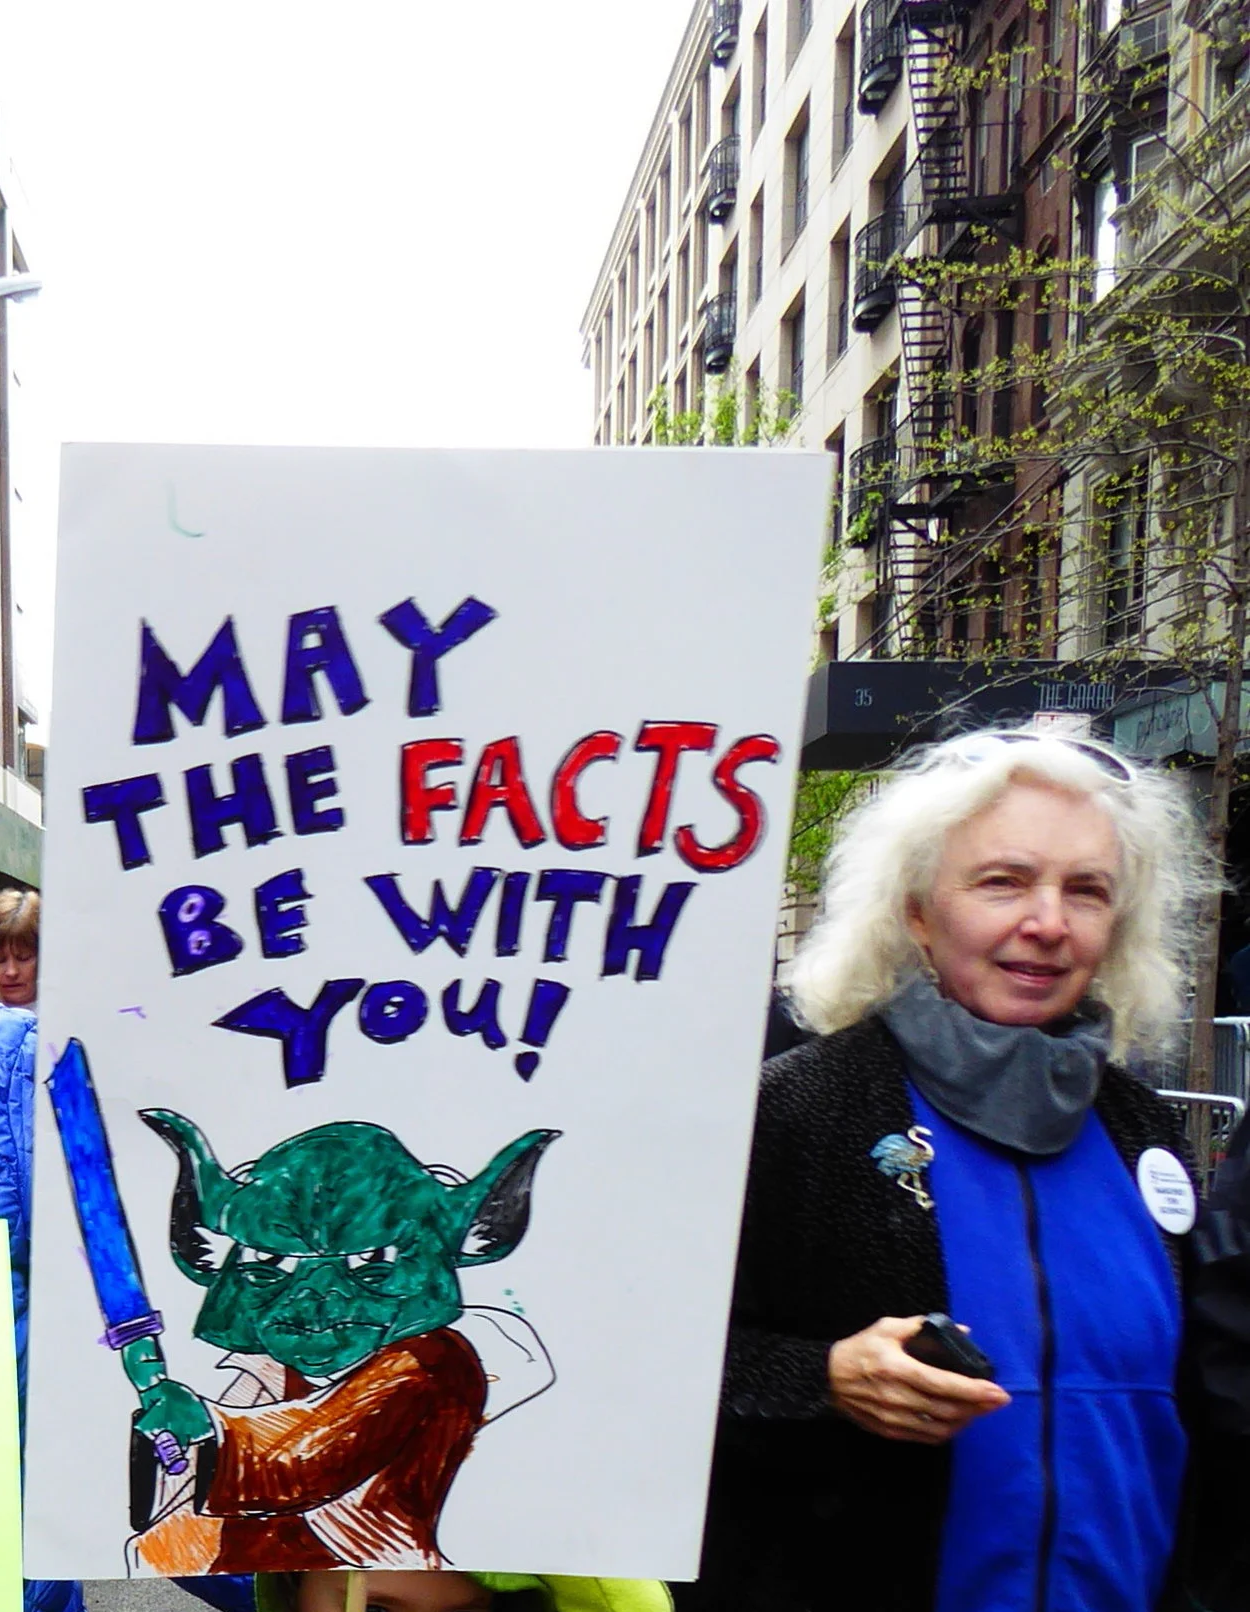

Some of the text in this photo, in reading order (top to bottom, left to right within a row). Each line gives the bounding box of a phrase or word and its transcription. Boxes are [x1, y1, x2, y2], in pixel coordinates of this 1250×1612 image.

[132, 595, 499, 745] MAY
[854, 688, 873, 707] 35
[1039, 683, 1064, 709] THE
[82, 719, 782, 873] THE FACTS
[157, 866, 699, 982] BE WITH
